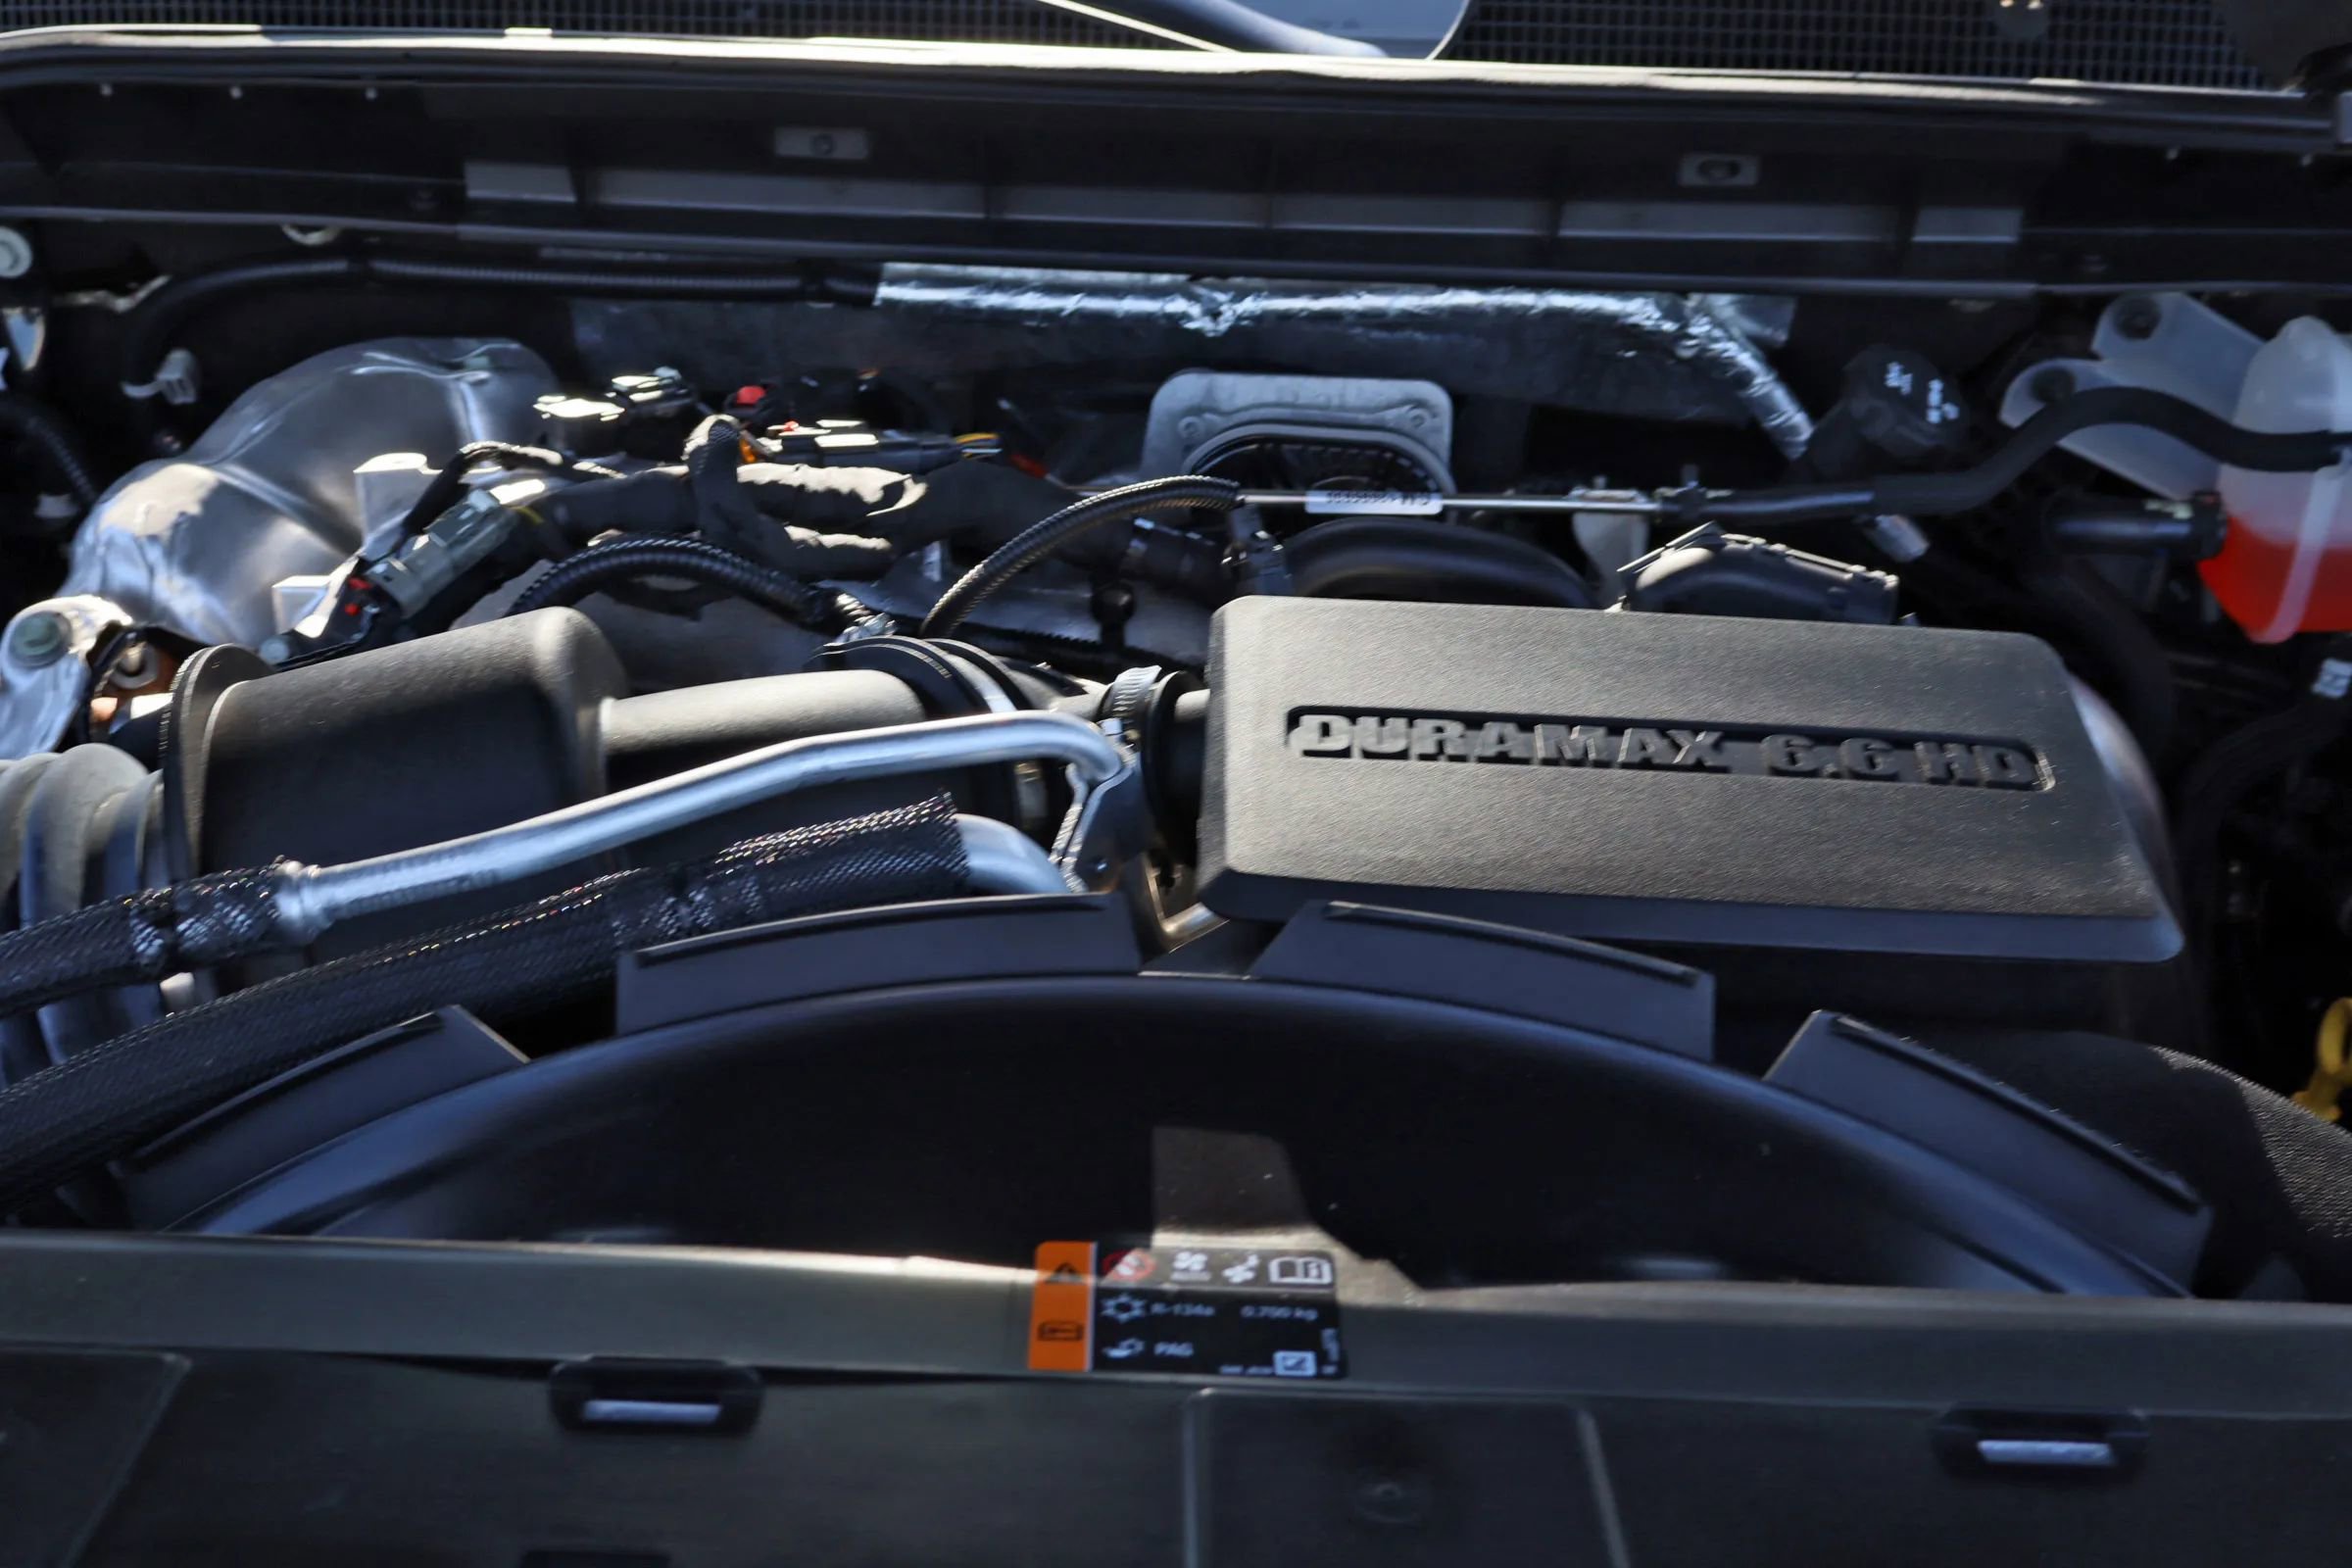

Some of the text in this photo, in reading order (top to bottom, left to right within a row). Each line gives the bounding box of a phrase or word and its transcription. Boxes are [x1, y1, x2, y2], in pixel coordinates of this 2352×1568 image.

[1293, 713, 2038, 790] DURAMAX 6.6 HD
